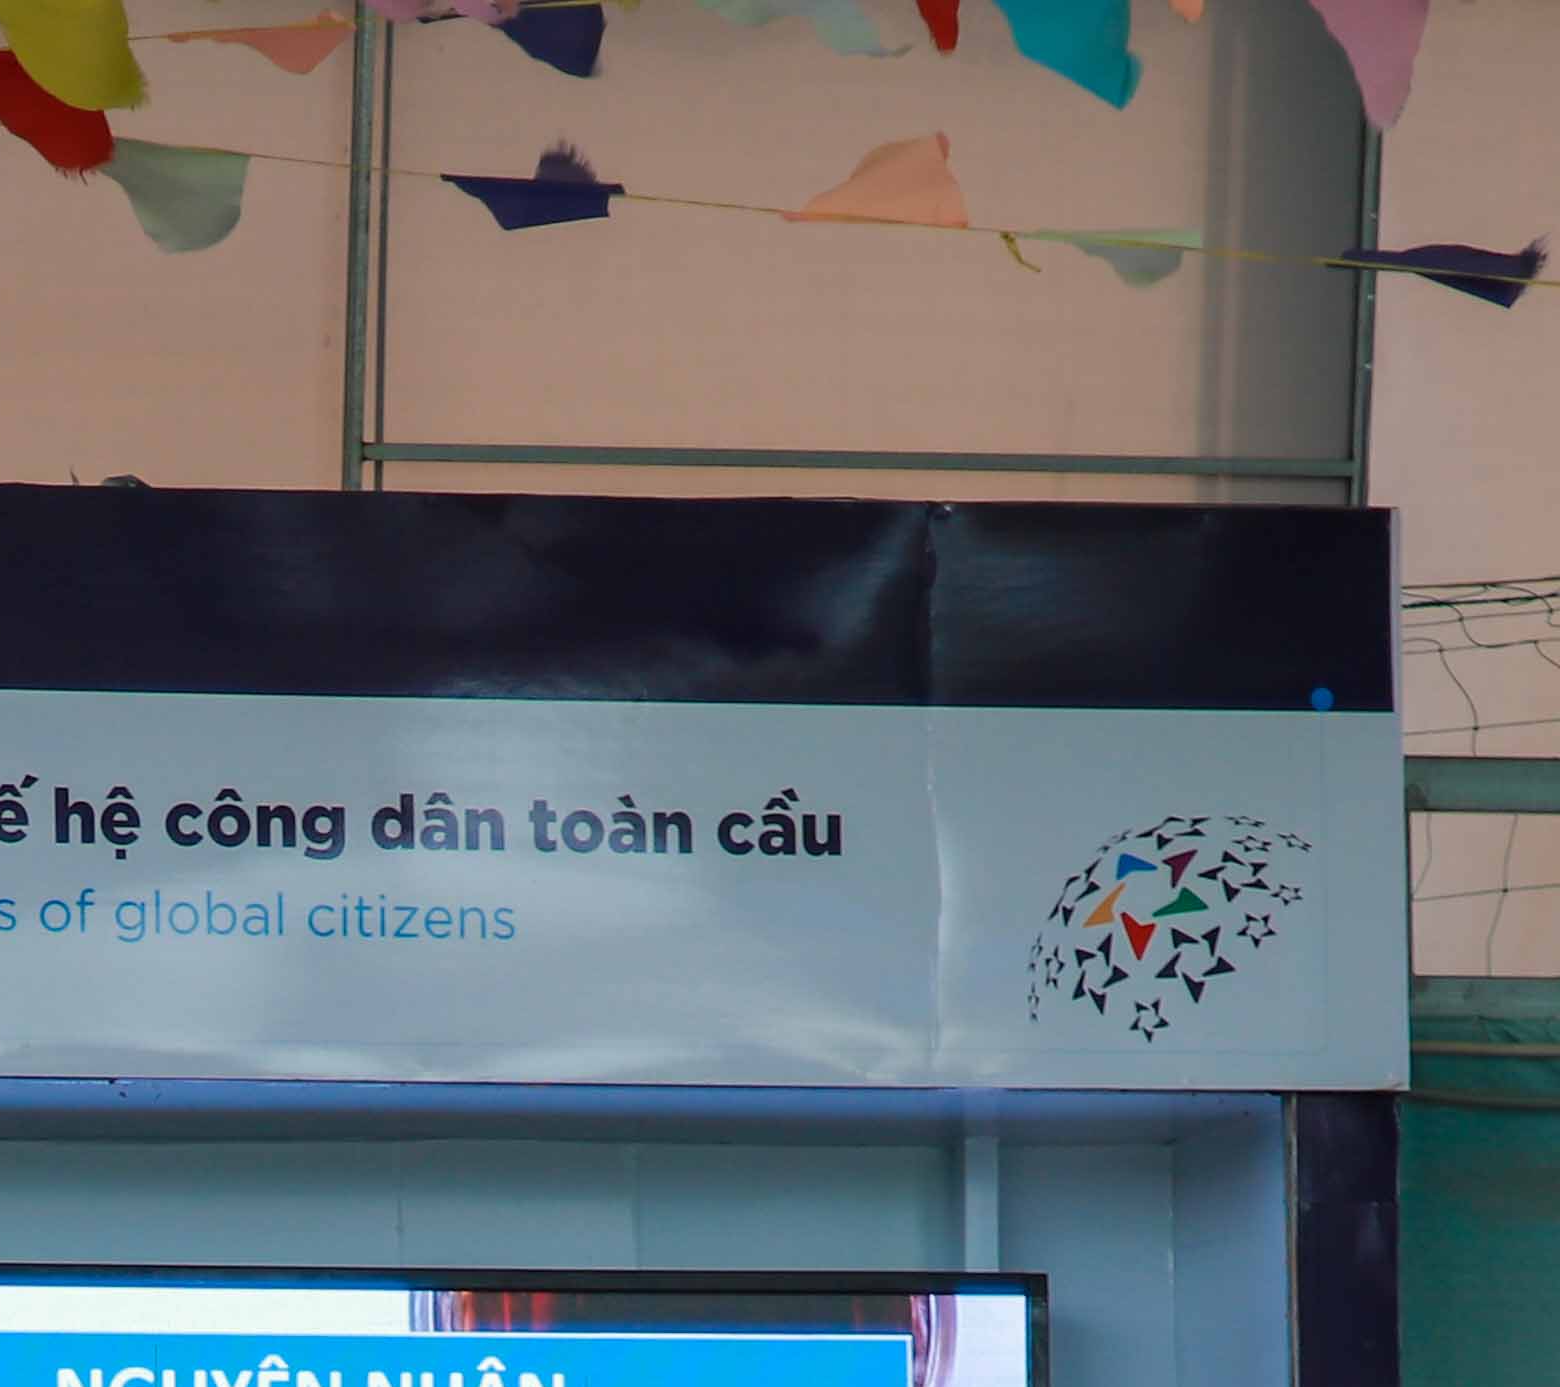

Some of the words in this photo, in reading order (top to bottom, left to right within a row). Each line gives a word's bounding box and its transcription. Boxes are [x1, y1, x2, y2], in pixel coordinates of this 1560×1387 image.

[52, 784, 144, 863] hệ
[162, 786, 347, 862] công
[369, 791, 506, 853] dân
[533, 793, 695, 857] toàn
[714, 786, 844, 860] cầu
[37, 885, 97, 935] of
[113, 889, 286, 944] global
[305, 896, 517, 942] citizens
